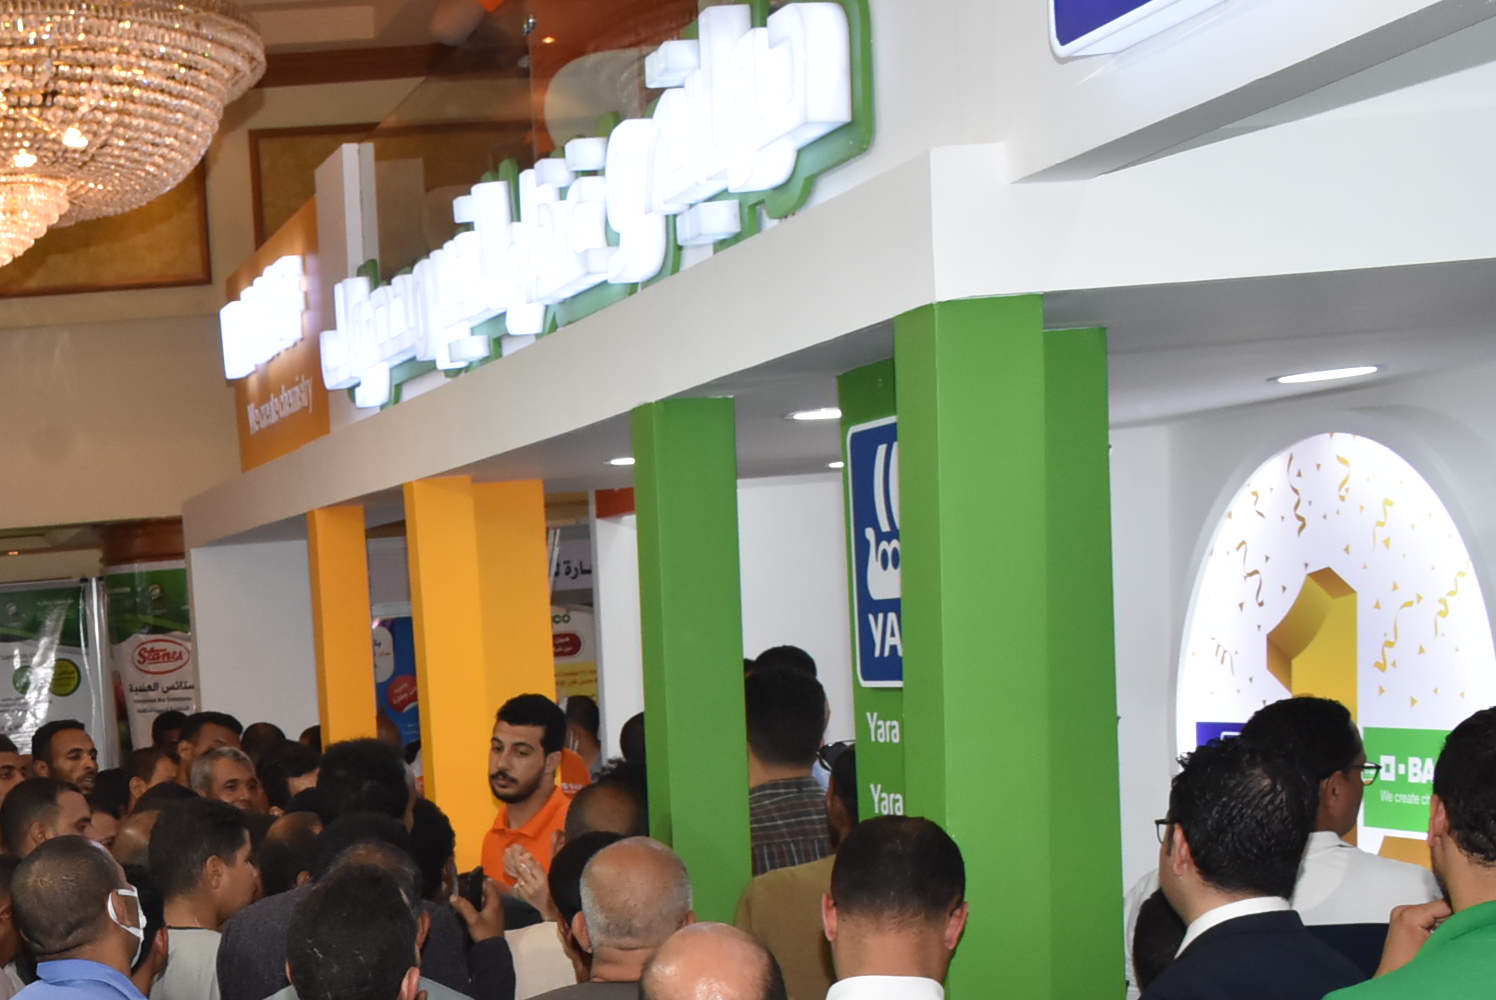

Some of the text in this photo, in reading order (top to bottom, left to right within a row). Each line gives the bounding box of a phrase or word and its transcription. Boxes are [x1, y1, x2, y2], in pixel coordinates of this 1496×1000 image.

[868, 611, 903, 658] YA
[866, 712, 900, 743] Yara
[870, 784, 903, 815] Yara
